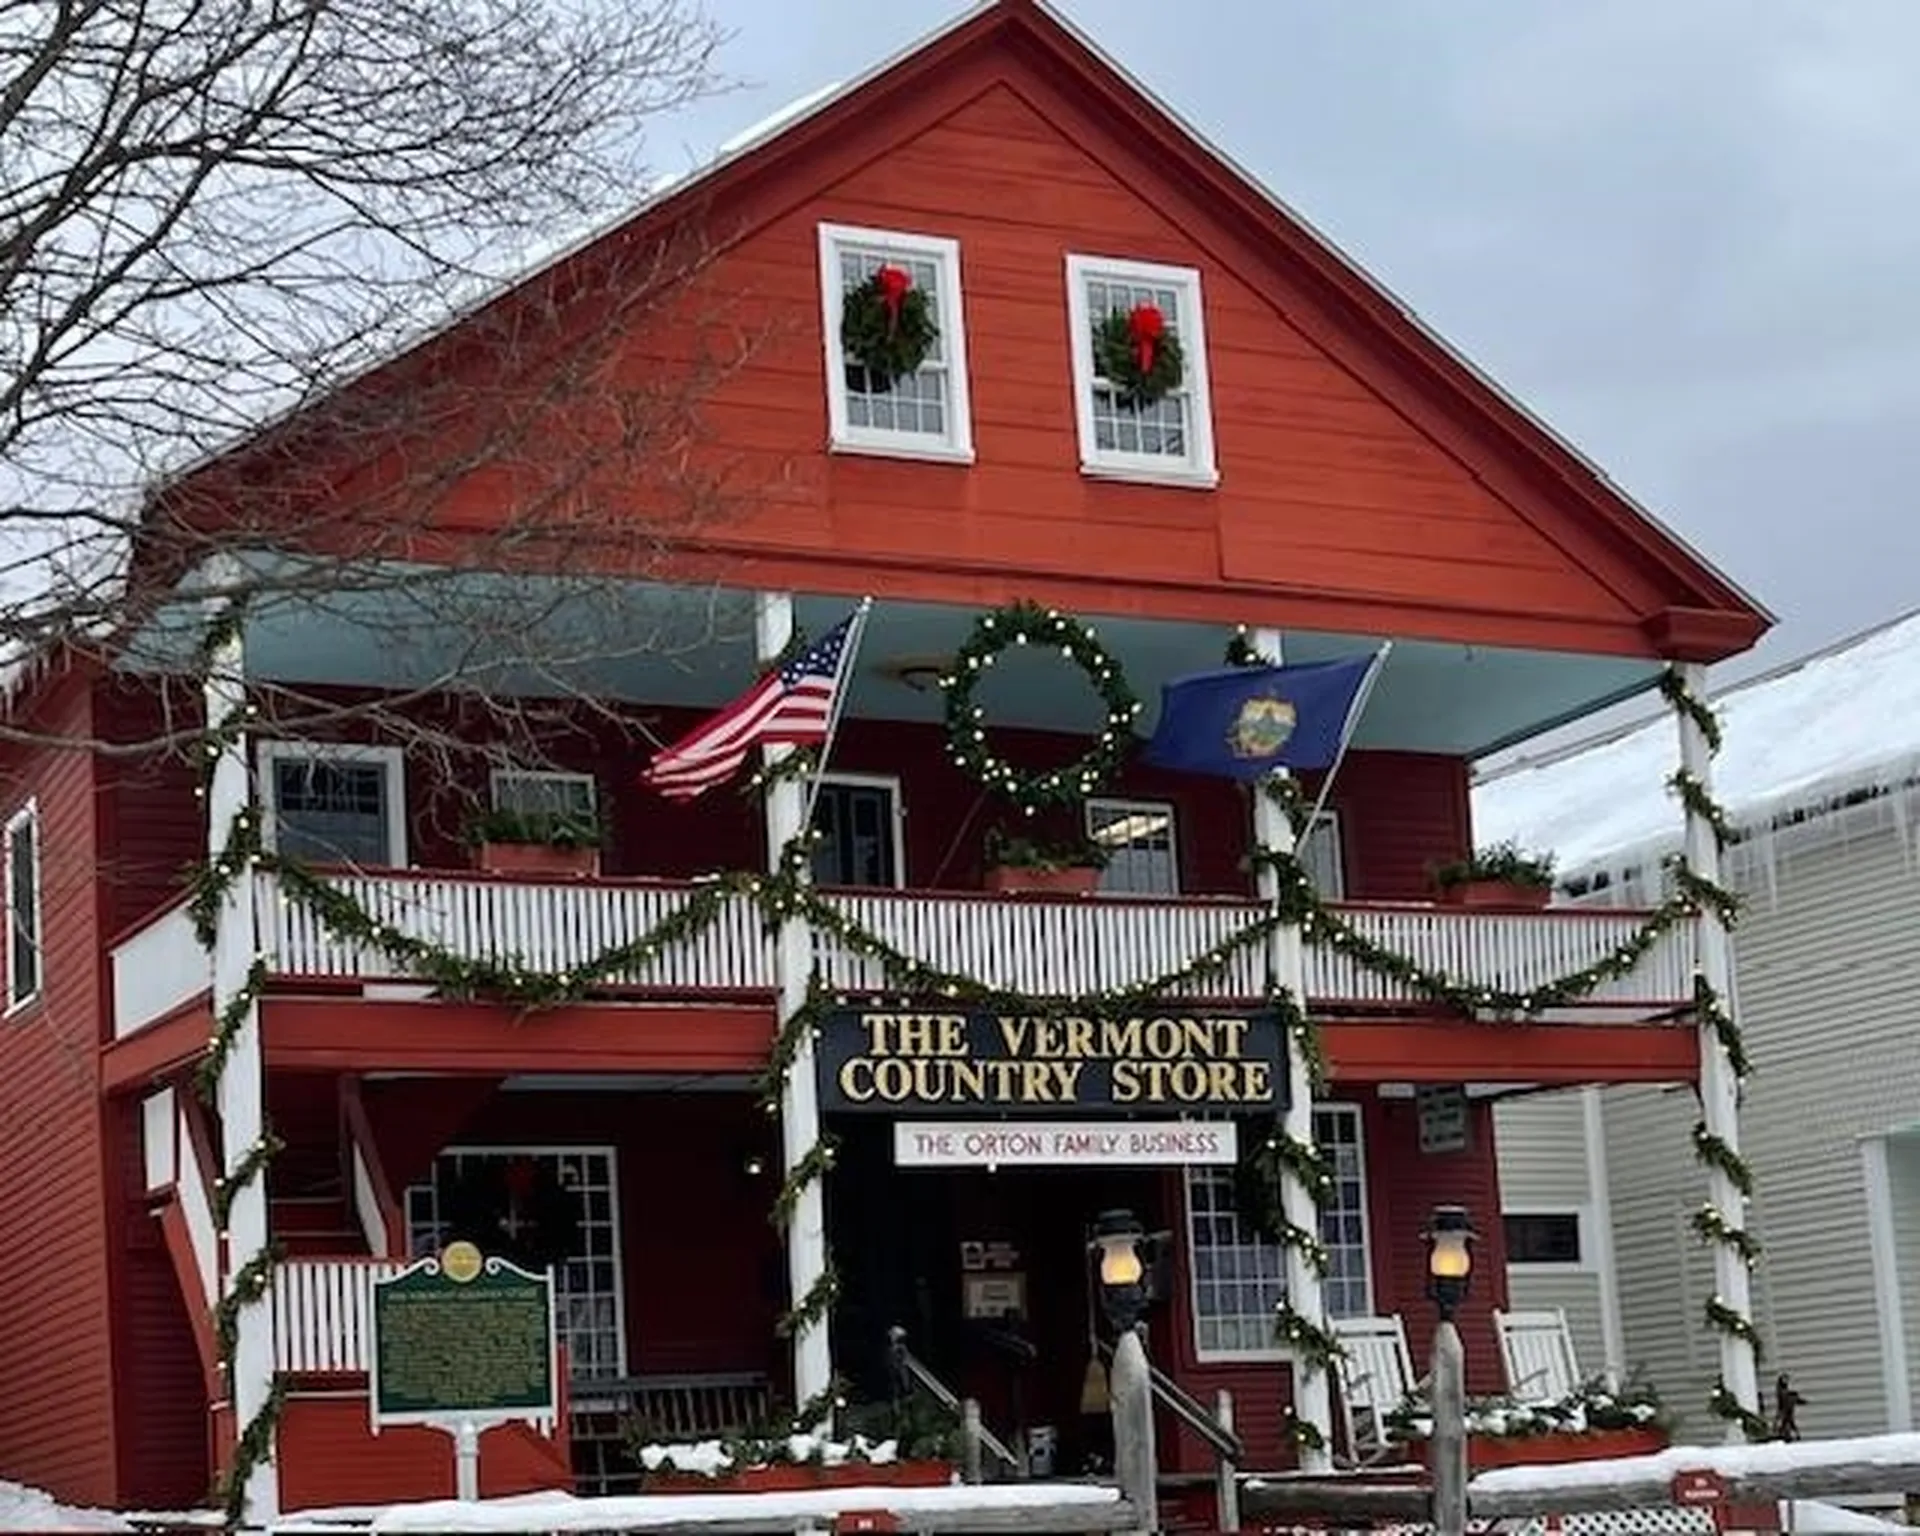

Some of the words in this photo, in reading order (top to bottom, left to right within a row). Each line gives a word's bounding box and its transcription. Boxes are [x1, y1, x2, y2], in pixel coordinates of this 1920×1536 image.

[861, 1014, 969, 1057] THE
[999, 1016, 1249, 1058] VERMONT
[839, 1058, 1083, 1102] COUNTRY
[1111, 1060, 1274, 1100] STORE
[915, 1134, 954, 1155] THE
[964, 1134, 1043, 1155] ORTON
[1054, 1134, 1119, 1154] FAMILY
[1131, 1132, 1219, 1154] BUSINESS
